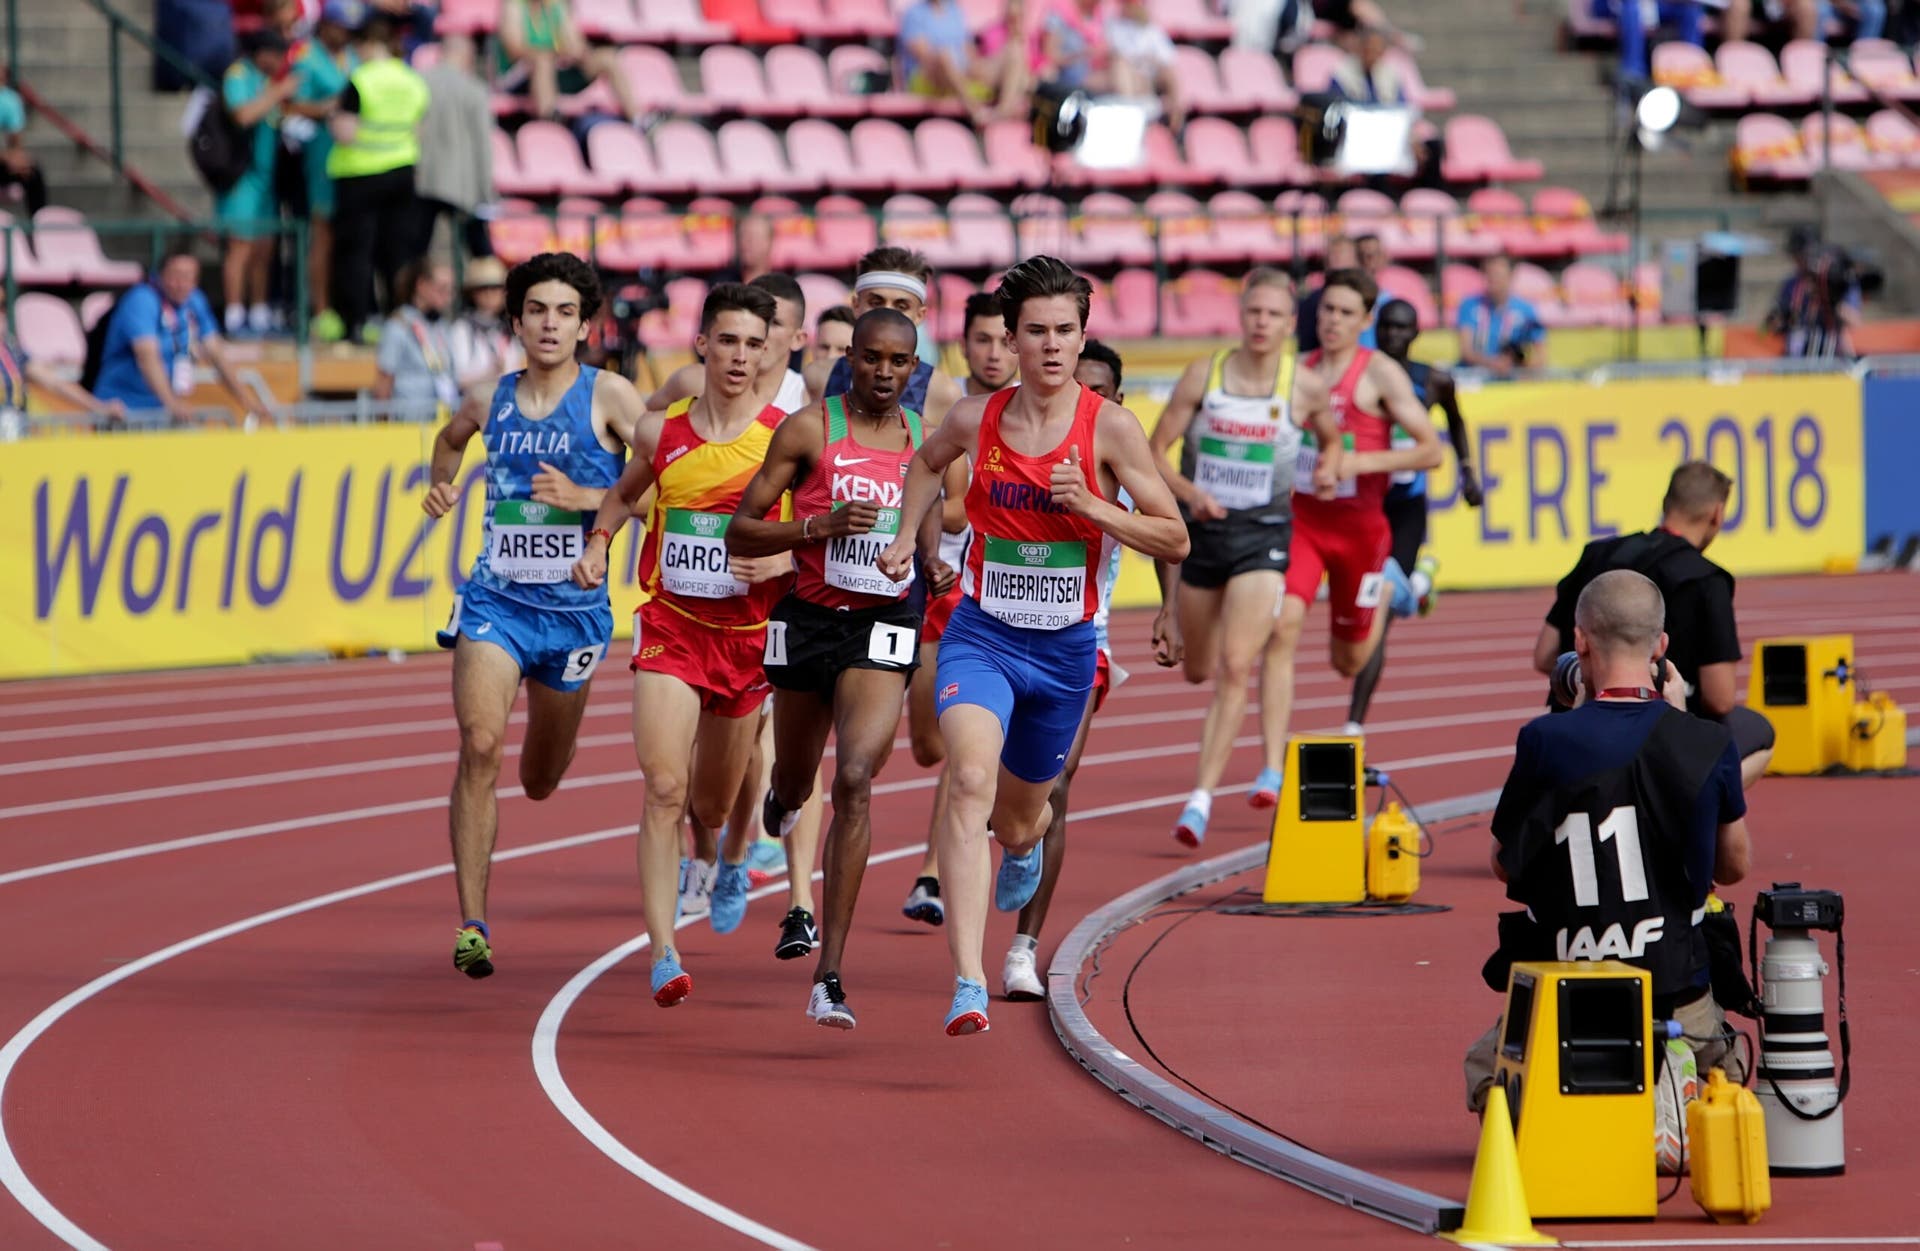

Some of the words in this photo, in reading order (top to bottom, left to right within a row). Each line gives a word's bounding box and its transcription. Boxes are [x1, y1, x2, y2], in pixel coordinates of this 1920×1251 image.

[500, 431, 570, 454] ITALIA
[832, 472, 902, 508] KENY
[990, 480, 1070, 514] NORW
[33, 465, 304, 621] World
[498, 533, 576, 558] ARESE
[830, 537, 889, 567] MANA
[1021, 546, 1048, 556] KOTI
[665, 542, 729, 574] GARCI
[503, 569, 544, 580] TAMPERE
[546, 568, 569, 580] 2018
[837, 574, 884, 591] TAMPERE
[669, 578, 710, 594] TAMPERE
[712, 583, 735, 596] 2018
[985, 570, 1082, 604] INGEBRIGTSEN
[995, 610, 1043, 626] TAMPERE
[1046, 614, 1070, 627] 2018
[640, 644, 665, 660] ESP
[887, 632, 898, 656] 1
[576, 651, 594, 676] 9
[1554, 805, 1650, 907] 11
[1556, 916, 1665, 962] IAAF
